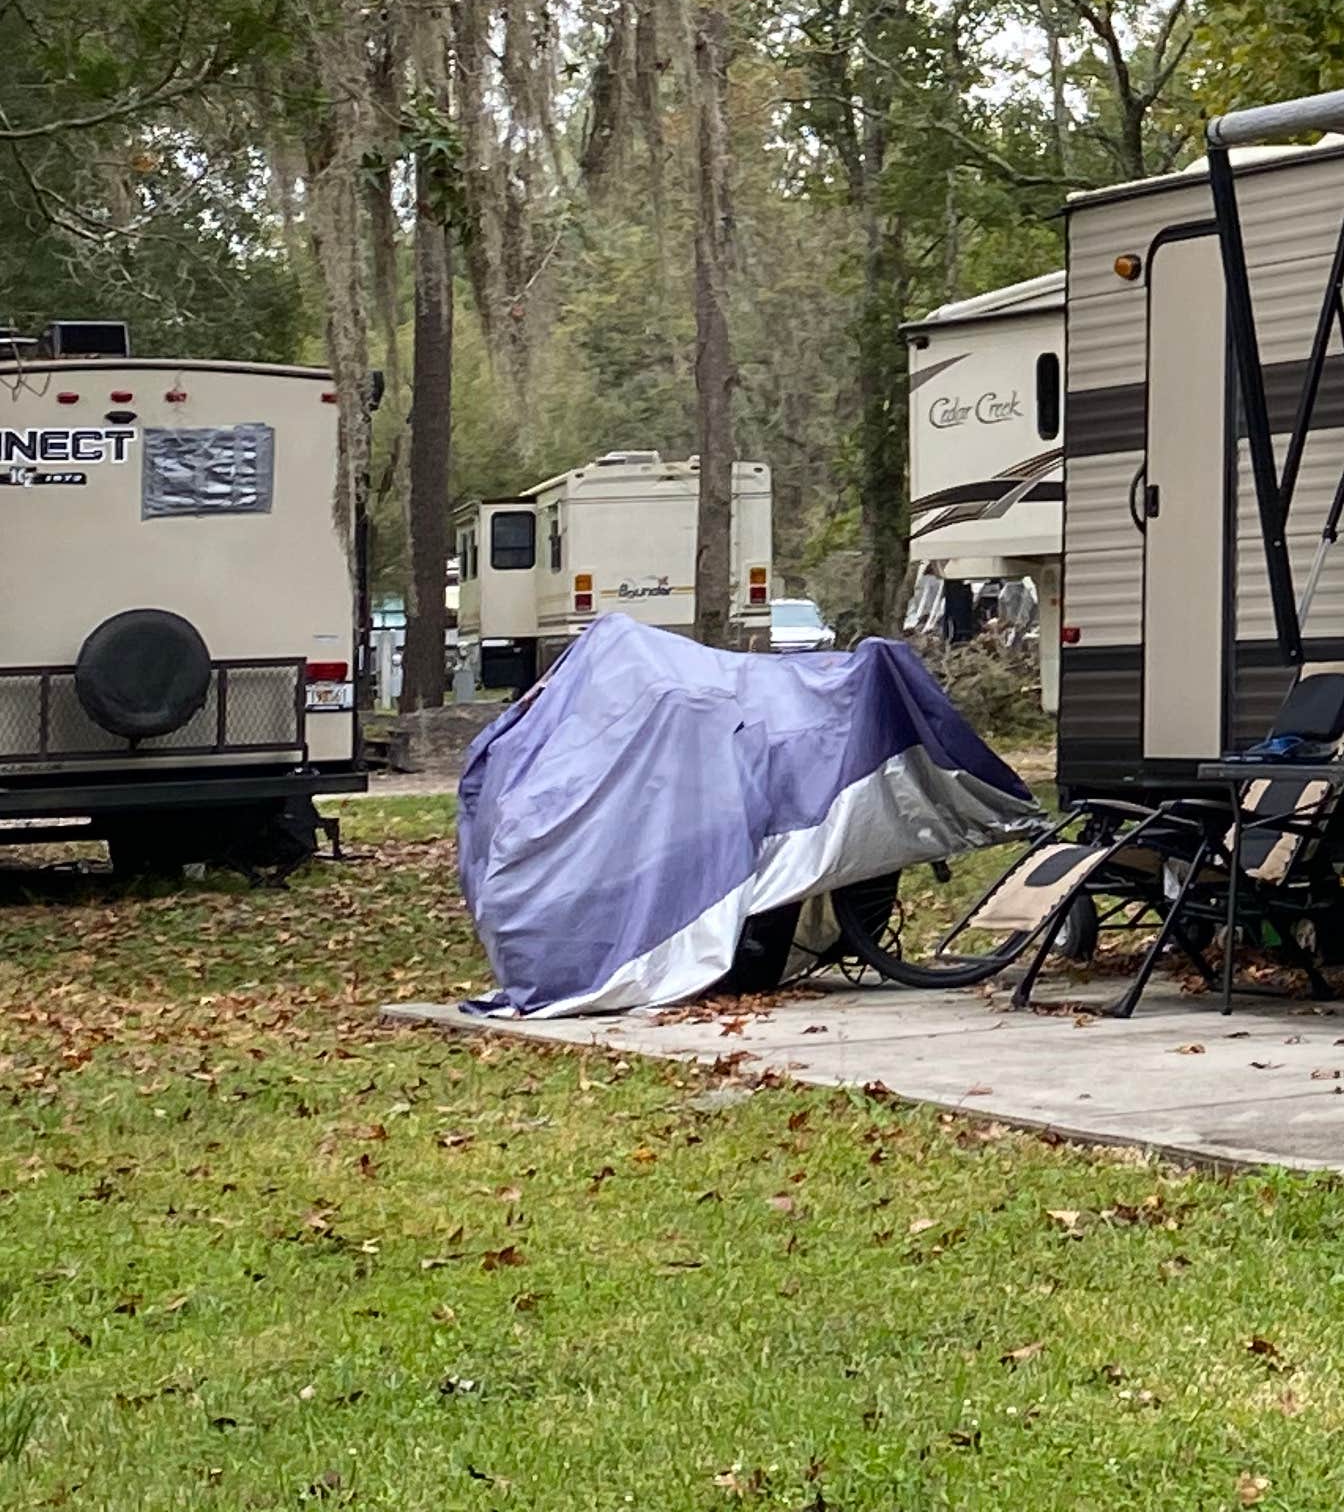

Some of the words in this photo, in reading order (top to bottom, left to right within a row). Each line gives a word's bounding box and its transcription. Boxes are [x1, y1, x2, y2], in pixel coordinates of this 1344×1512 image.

[929, 397, 973, 429] Cedar
[975, 390, 1024, 424] Creek
[0, 429, 136, 462] NECT
